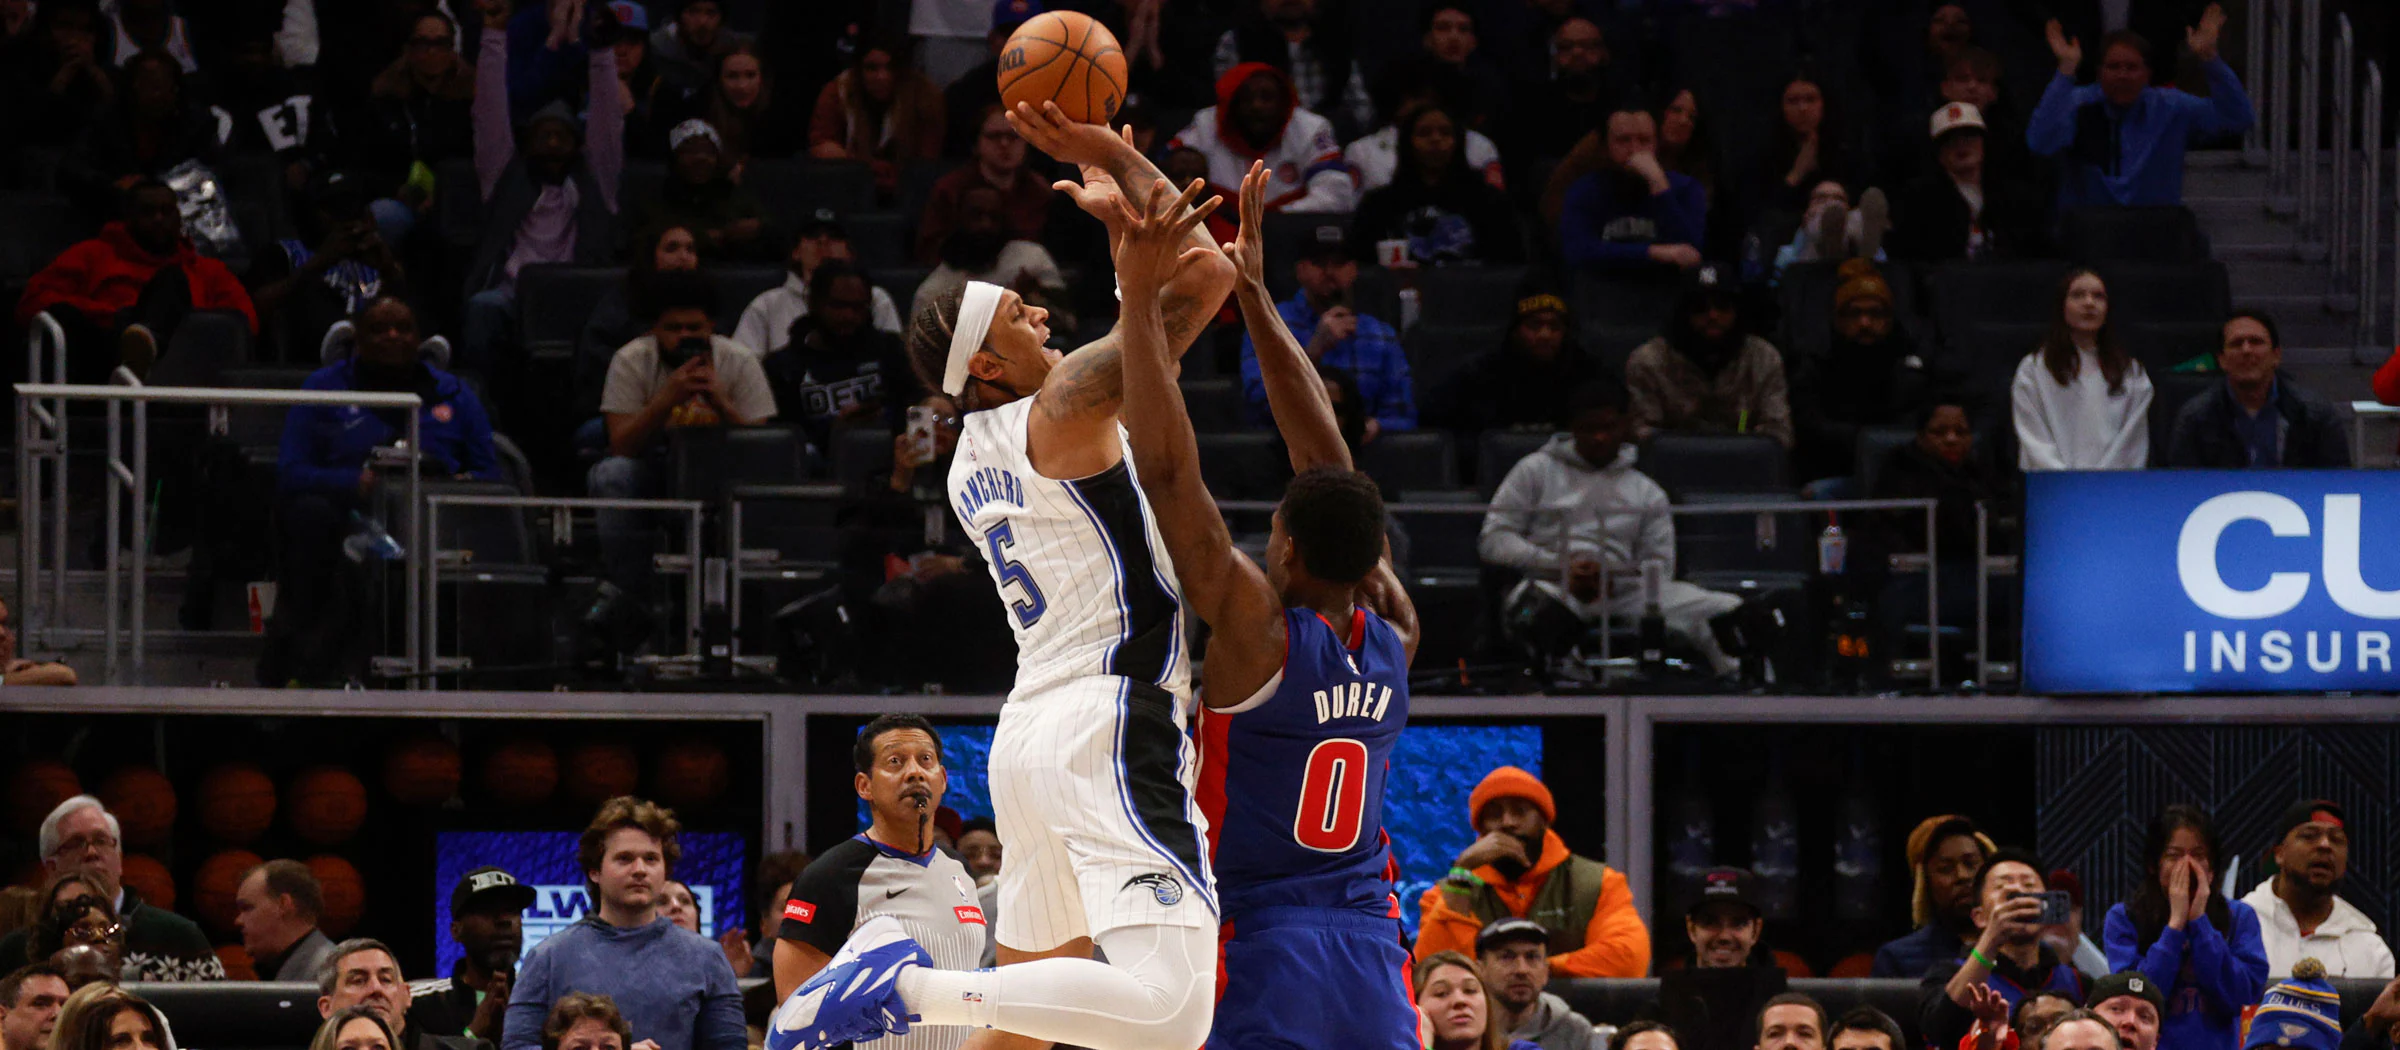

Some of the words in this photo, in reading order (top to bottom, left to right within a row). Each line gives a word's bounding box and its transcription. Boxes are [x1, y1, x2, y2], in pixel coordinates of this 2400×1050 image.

[984, 517, 1048, 630] 5
[2184, 630, 2392, 674] INSUR
[1313, 682, 1393, 725] DUREN
[1293, 738, 1368, 853] 0
